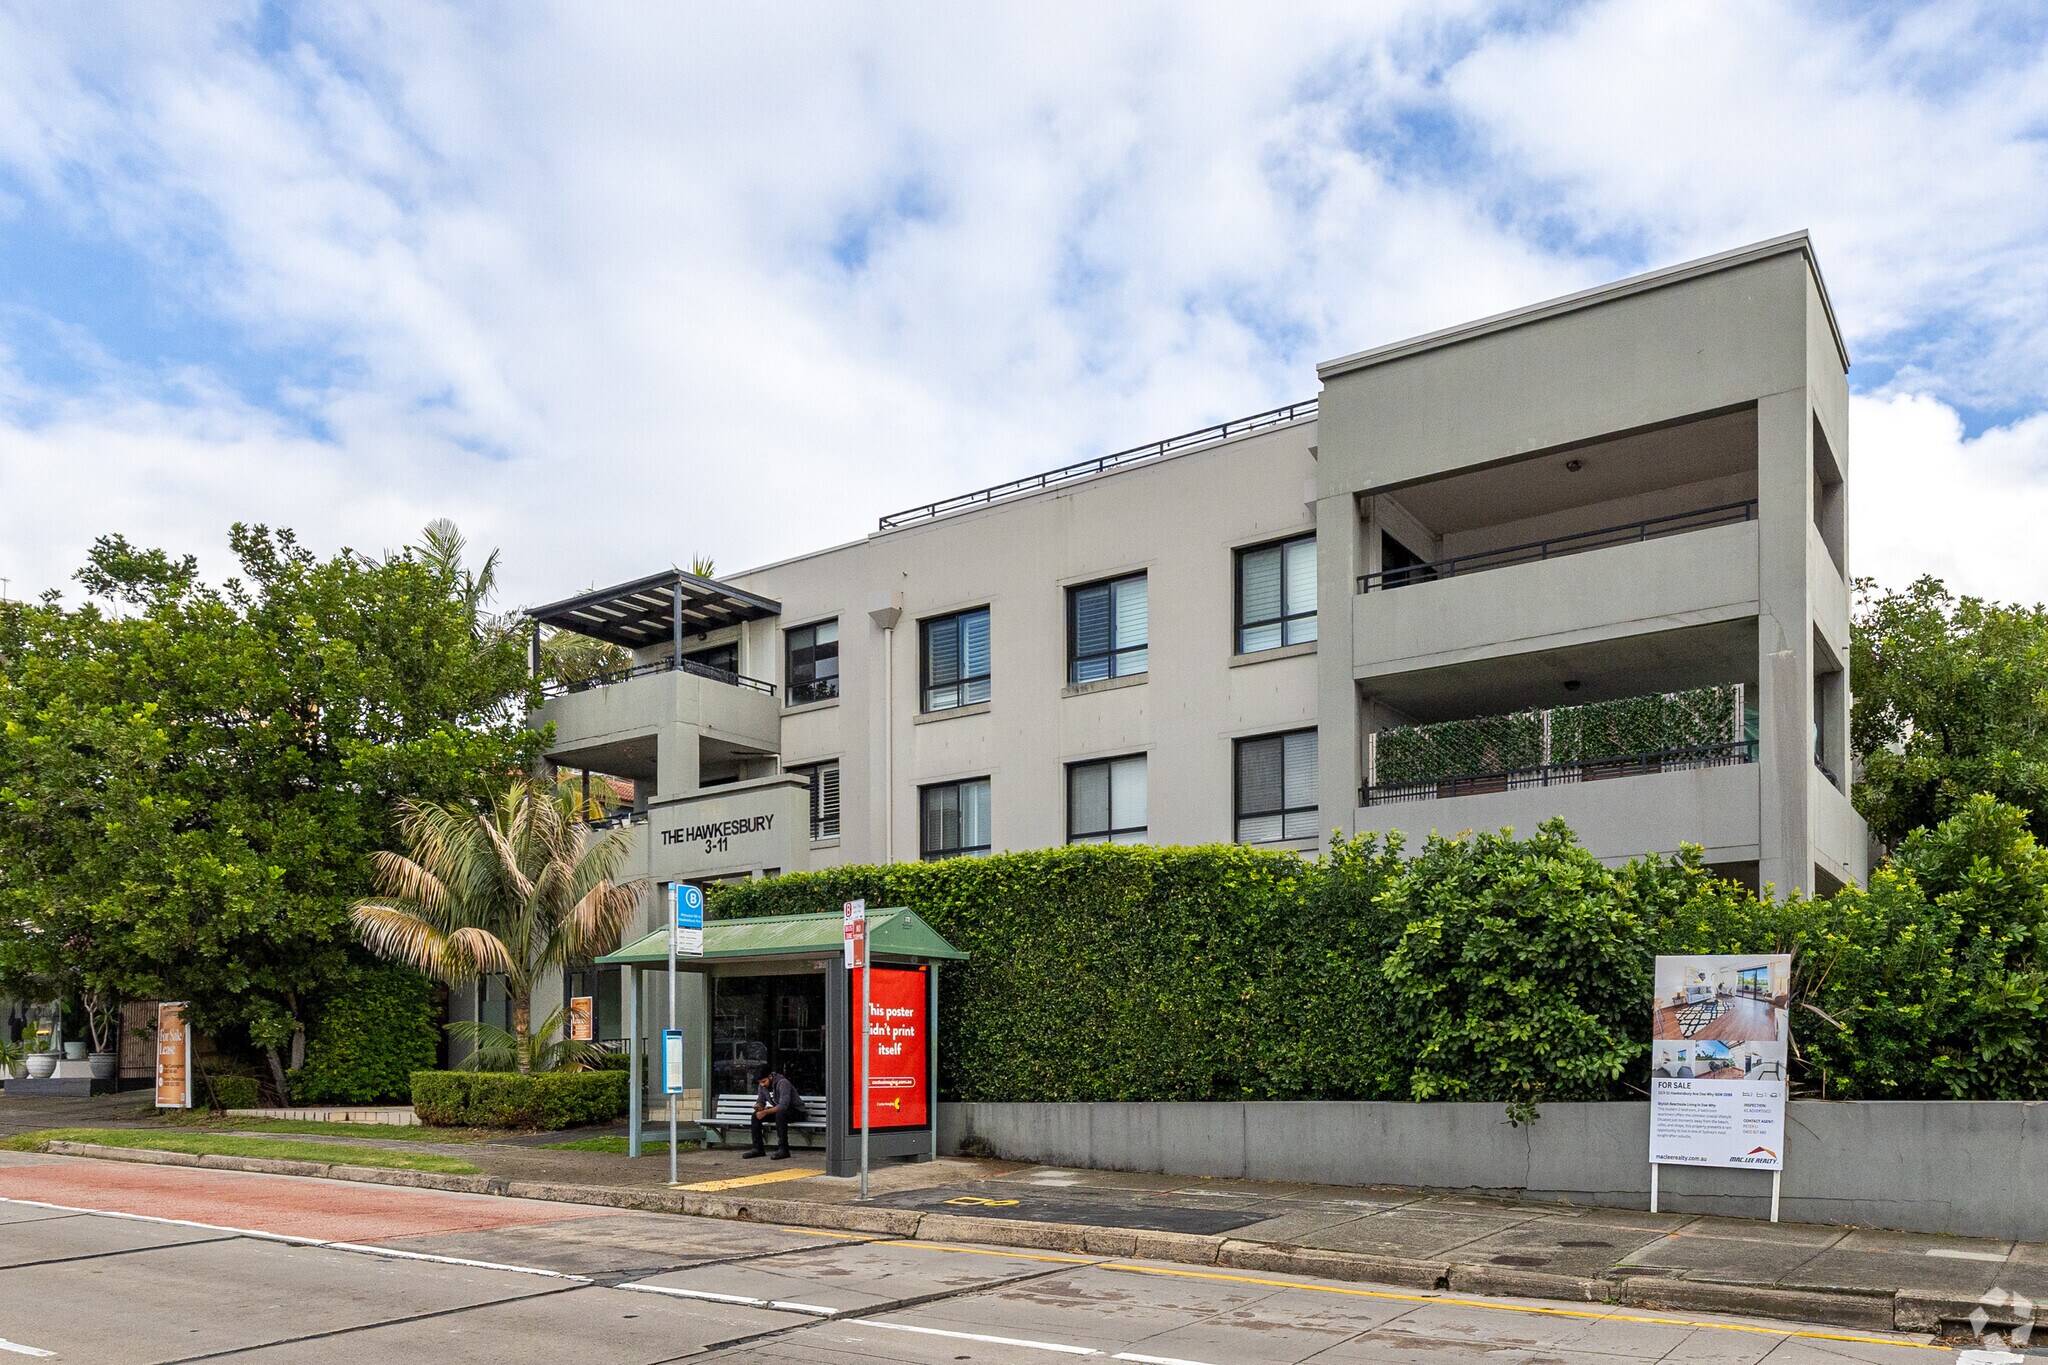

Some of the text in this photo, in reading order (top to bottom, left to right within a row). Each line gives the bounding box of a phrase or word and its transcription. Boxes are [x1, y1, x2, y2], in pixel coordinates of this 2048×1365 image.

[661, 814, 774, 845] THE HAWKESBURY
[705, 837, 728, 854] 3-11
[690, 893, 697, 904] B
[886, 1007, 914, 1021] poster
[870, 1022, 914, 1040] idn't print
[878, 1042, 902, 1055] itself
